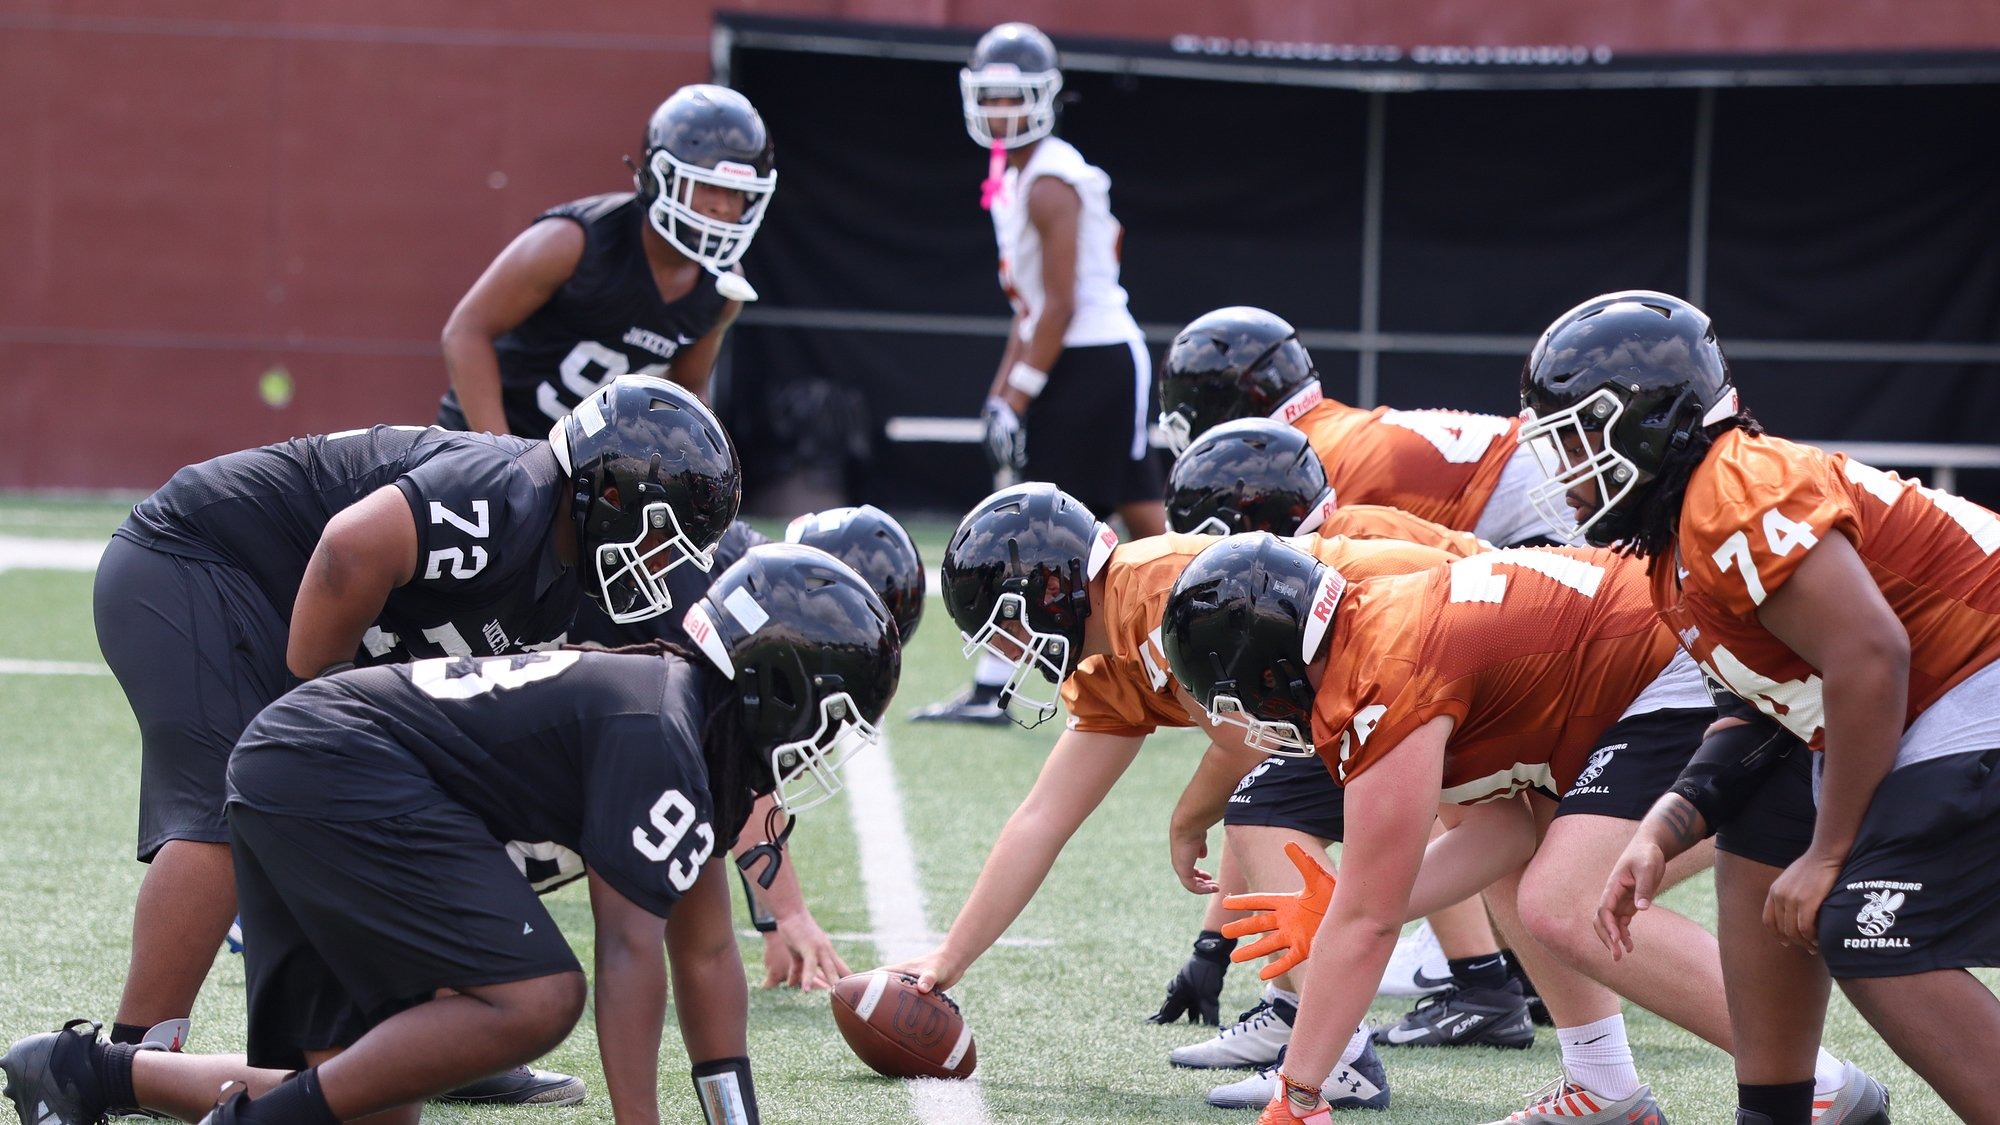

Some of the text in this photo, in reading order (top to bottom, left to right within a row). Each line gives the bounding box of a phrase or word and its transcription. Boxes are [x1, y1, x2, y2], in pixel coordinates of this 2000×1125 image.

[424, 500, 490, 579] 72
[1712, 507, 1819, 606] 74
[632, 789, 715, 892] 93
[1846, 880, 1923, 891] WAYNESBURG
[1843, 937, 1911, 949] FOOTBALL
